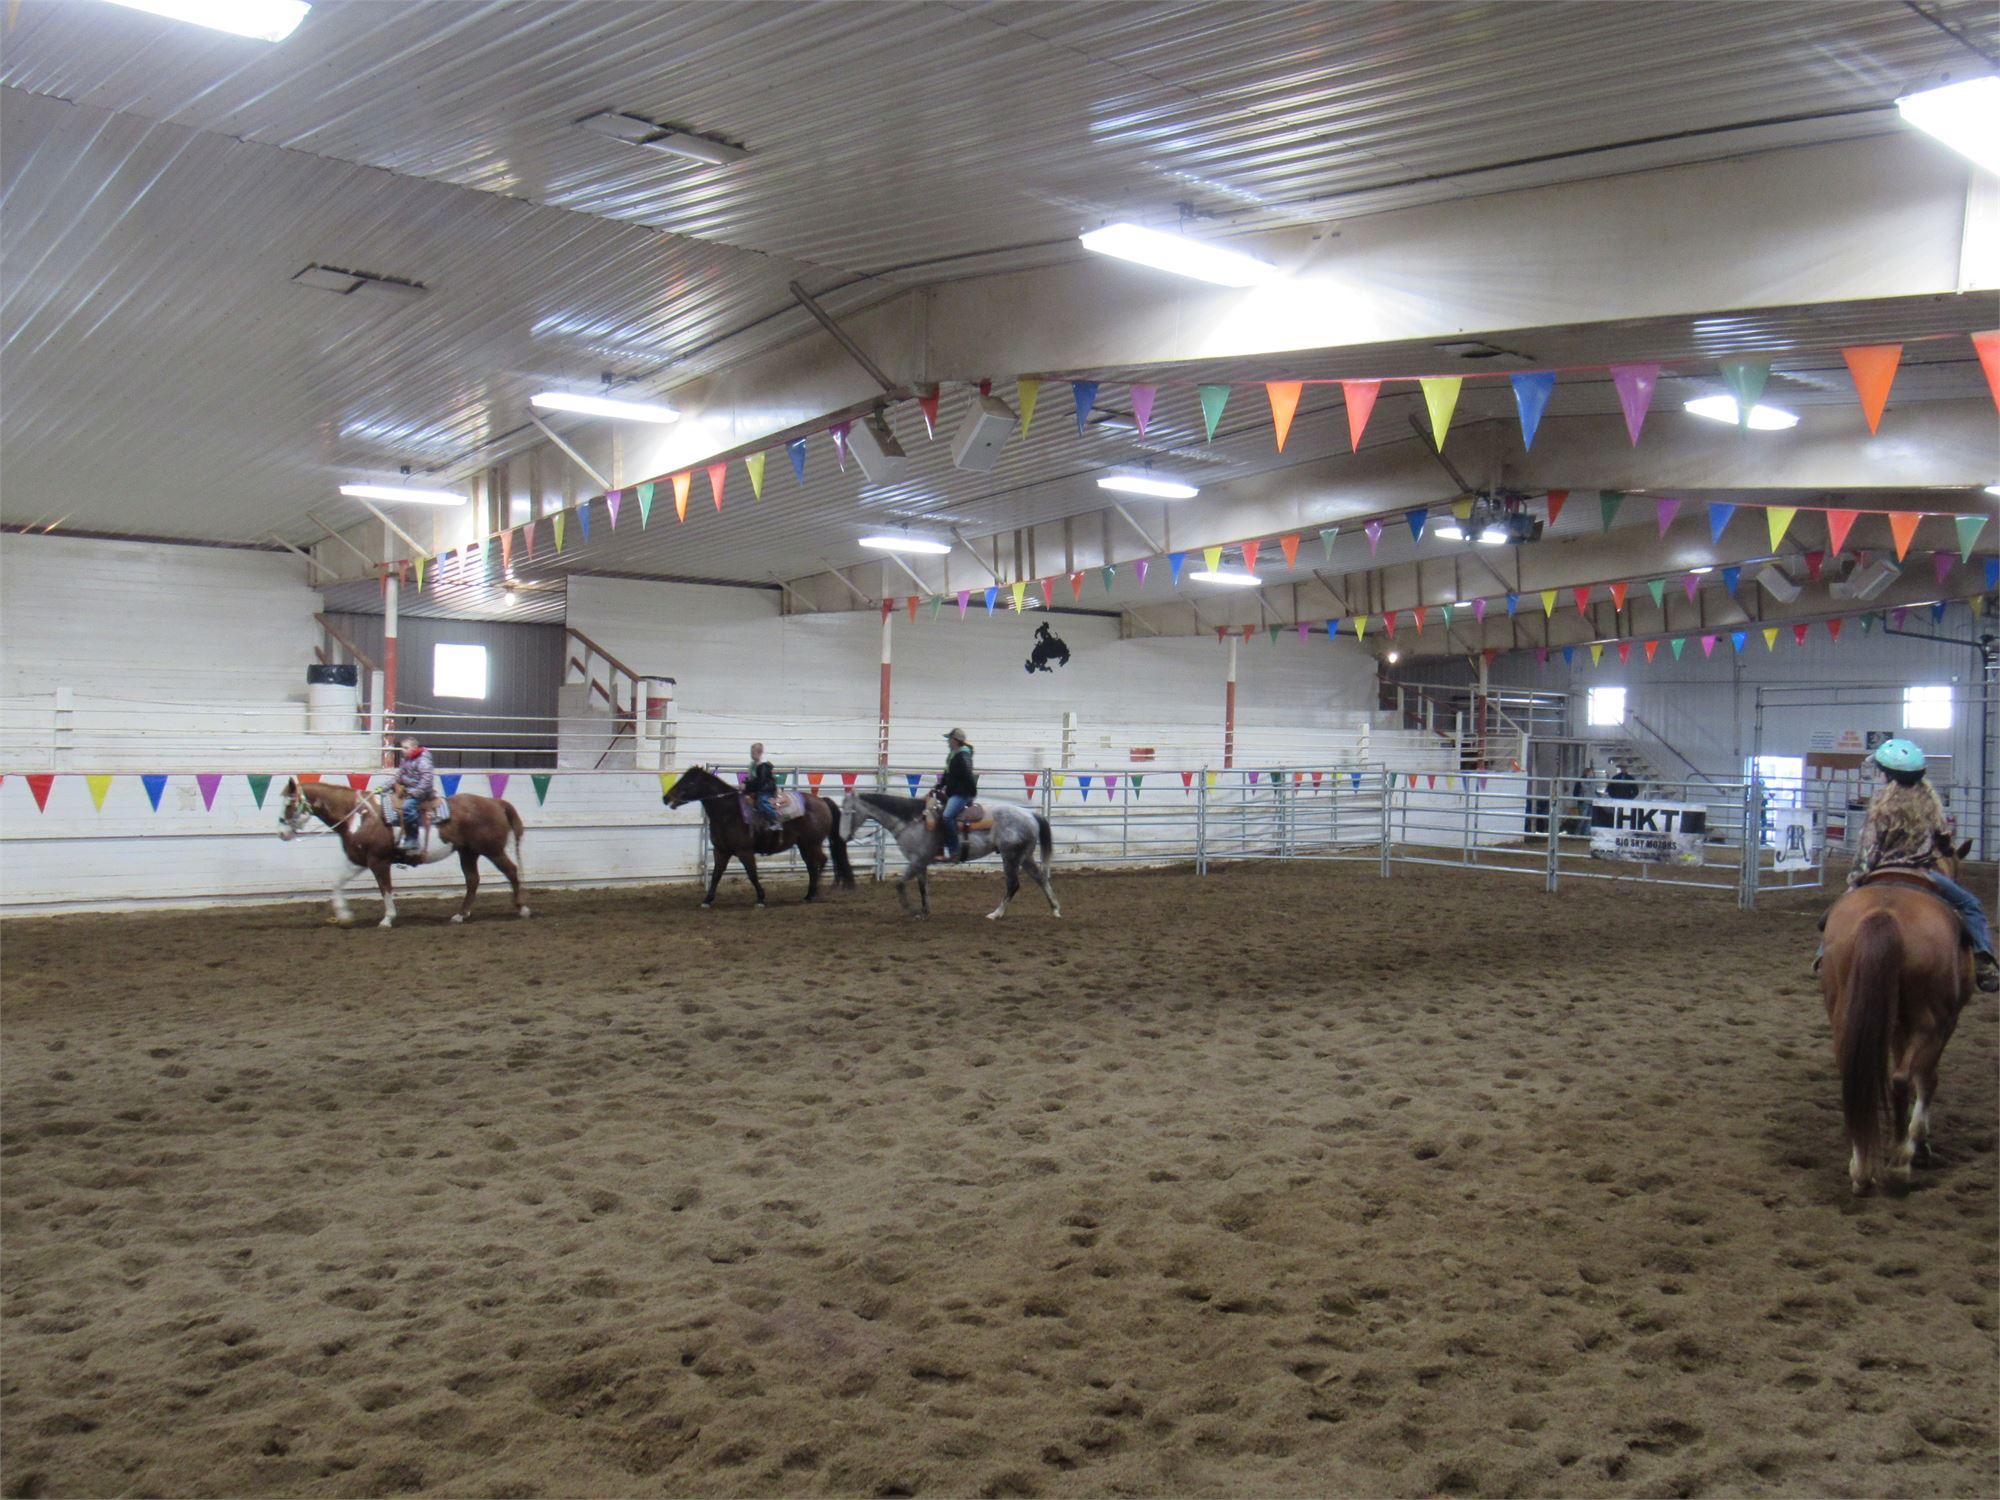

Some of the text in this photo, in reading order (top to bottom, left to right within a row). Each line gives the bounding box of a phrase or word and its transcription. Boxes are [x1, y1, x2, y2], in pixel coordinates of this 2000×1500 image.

[1616, 807, 1679, 832] HKT
[1615, 838, 1677, 850] BIG SKY MOTORS
